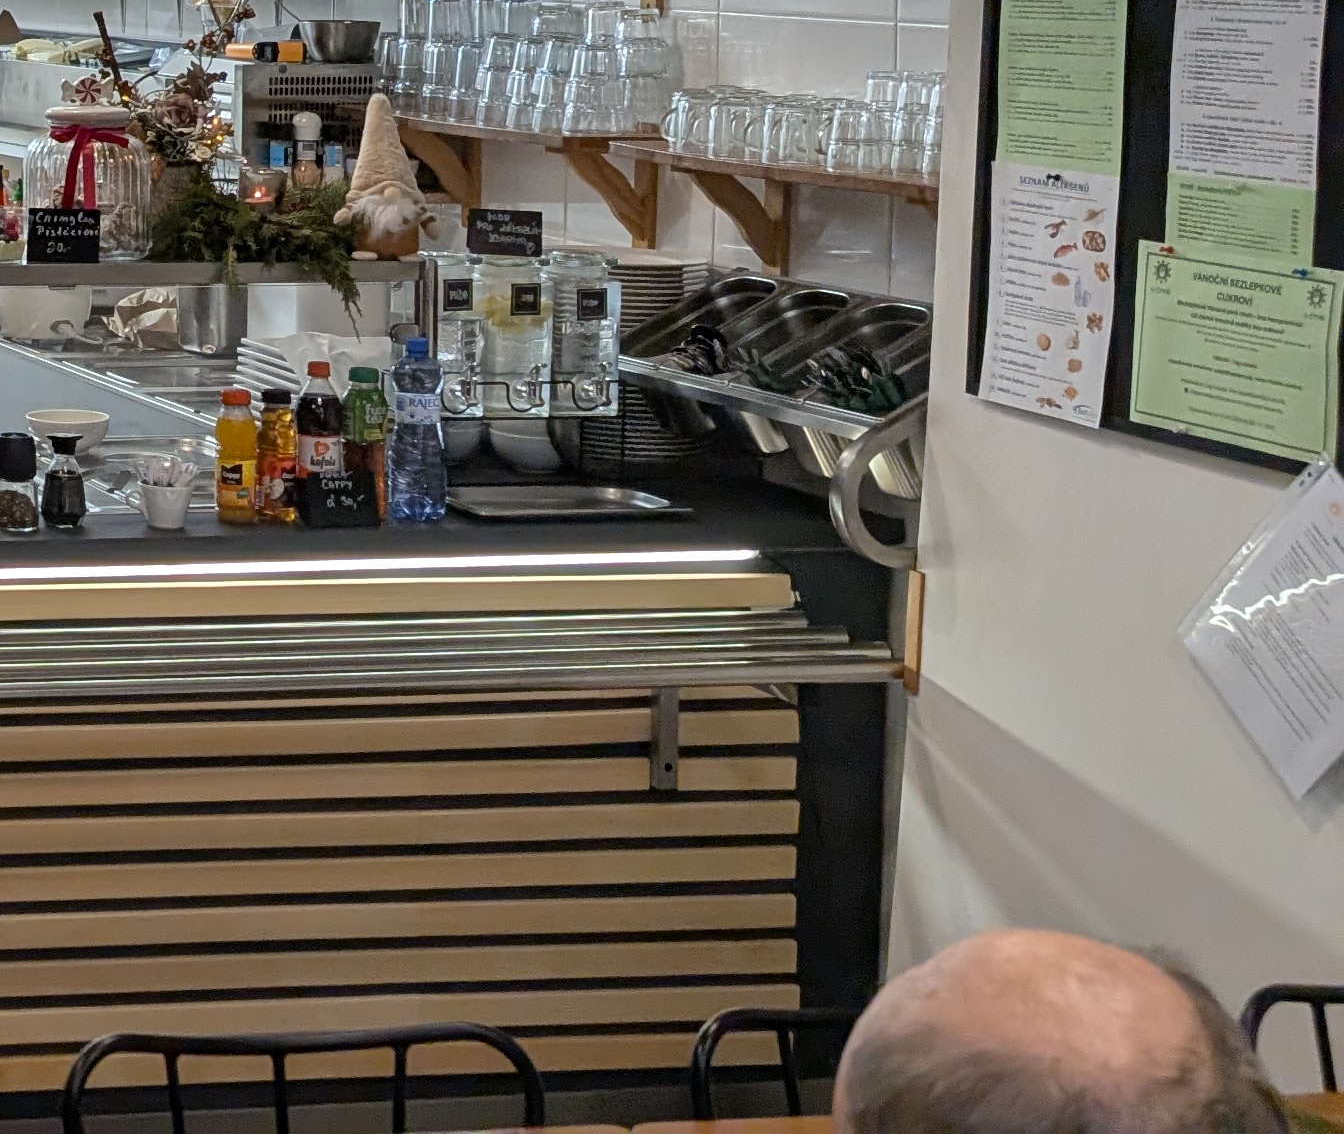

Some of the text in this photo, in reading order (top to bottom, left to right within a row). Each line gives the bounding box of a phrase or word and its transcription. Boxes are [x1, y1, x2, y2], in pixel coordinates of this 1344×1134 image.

[1216, 292, 1253, 306] CUKROVÍ
[408, 398, 439, 410] RAJEC
[310, 454, 336, 469] kofola
